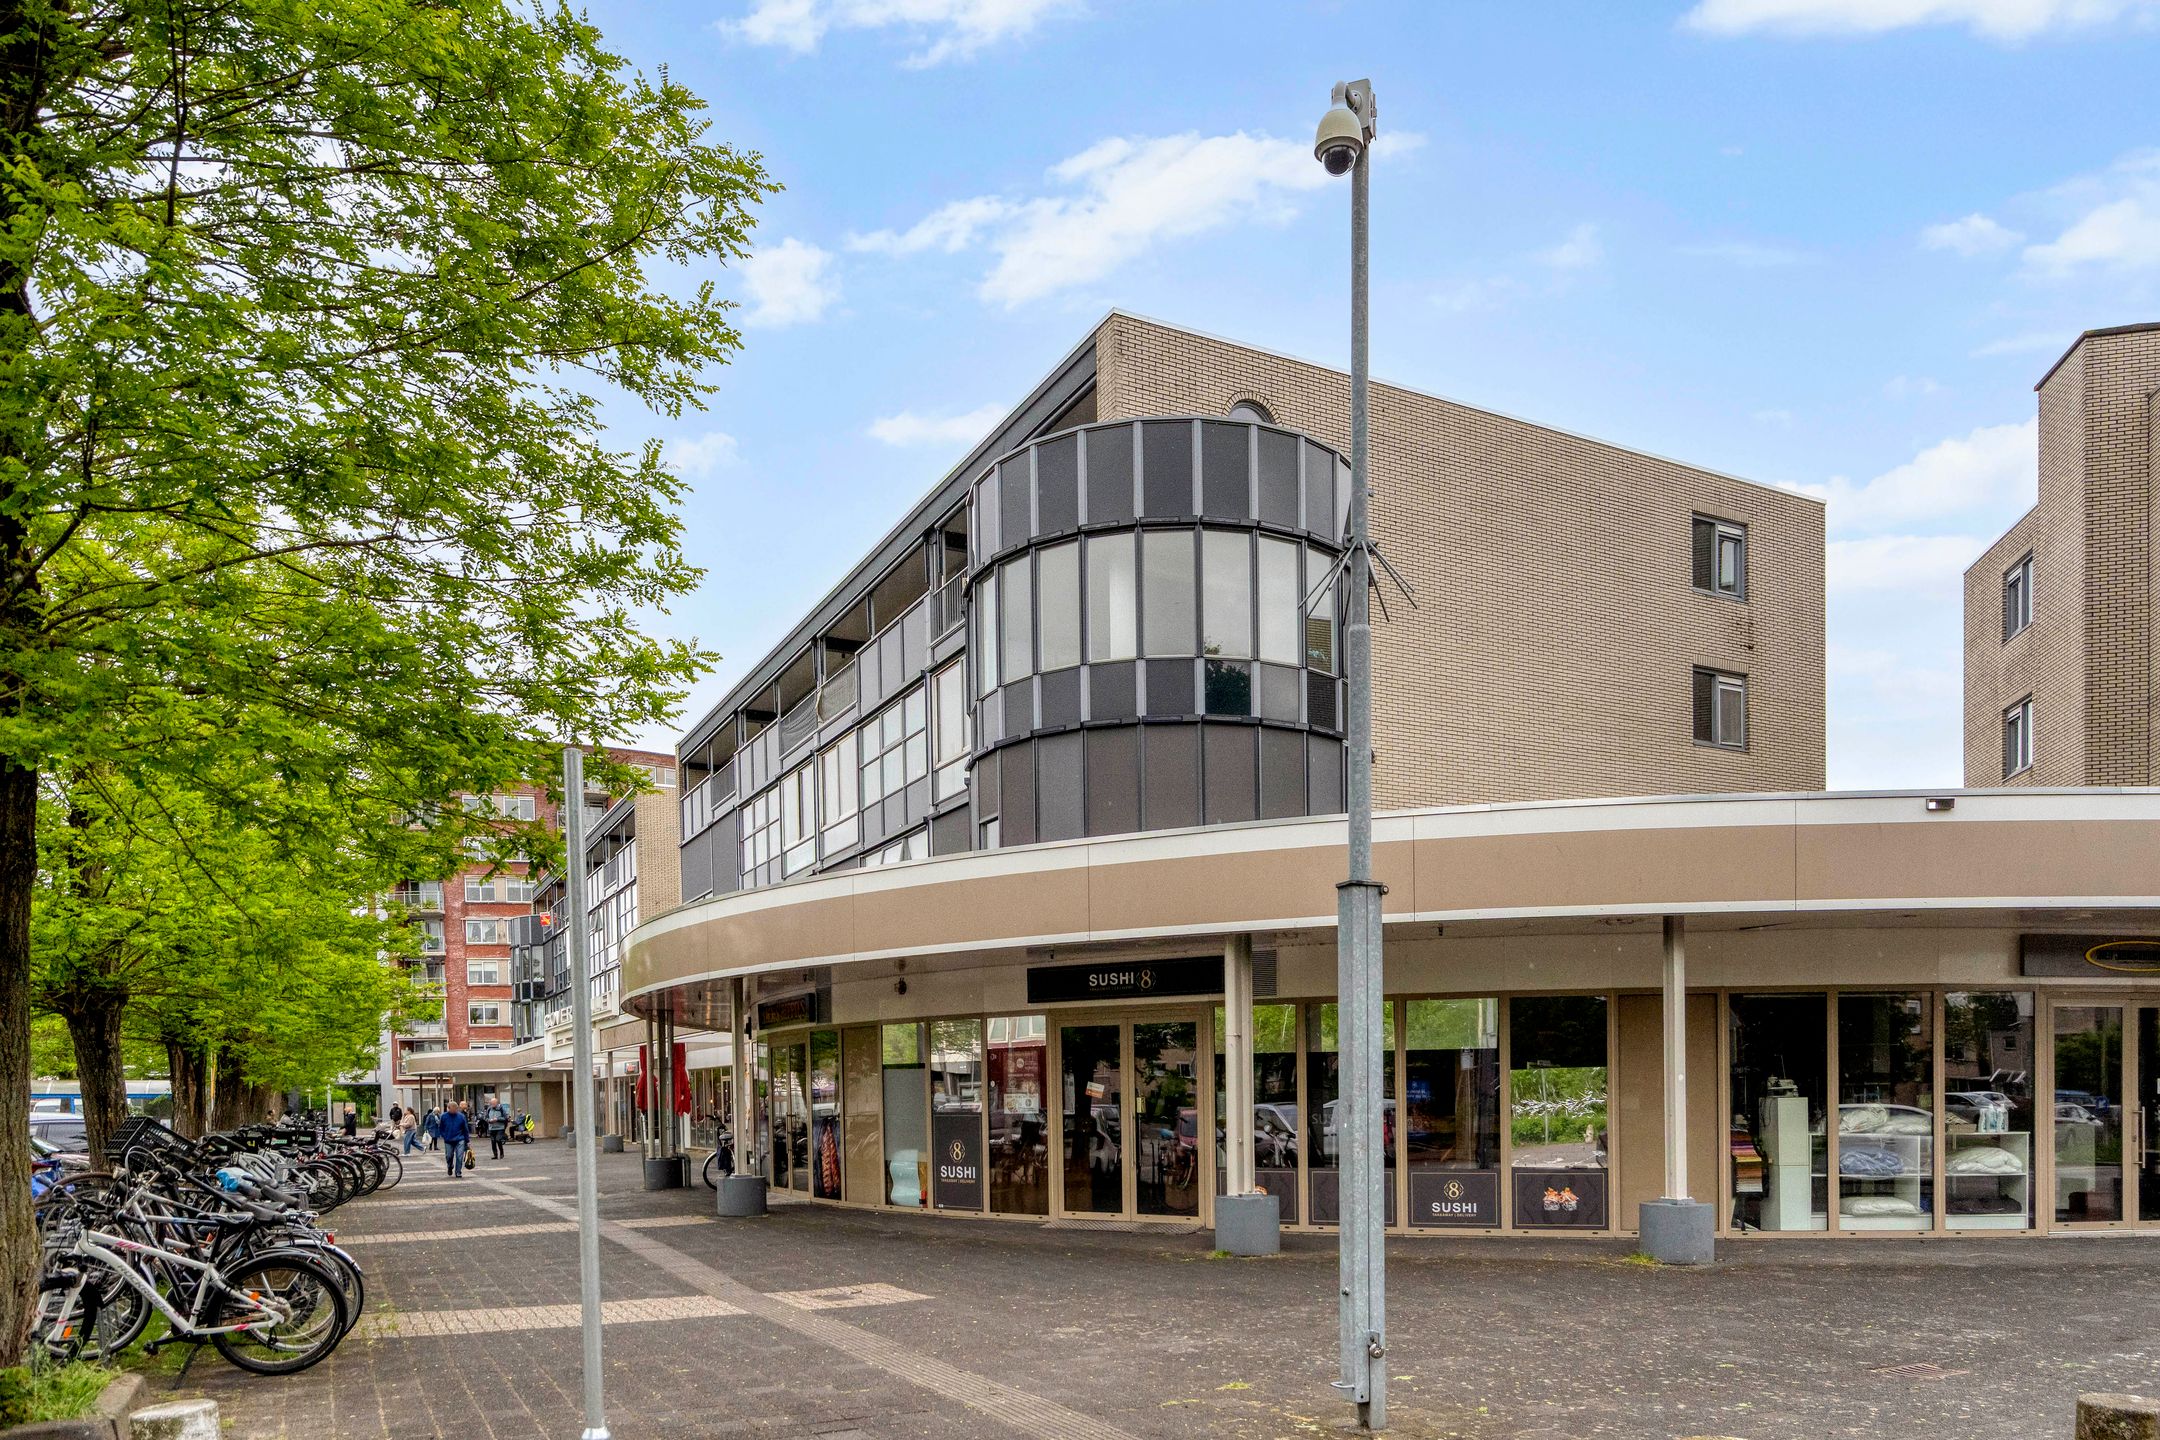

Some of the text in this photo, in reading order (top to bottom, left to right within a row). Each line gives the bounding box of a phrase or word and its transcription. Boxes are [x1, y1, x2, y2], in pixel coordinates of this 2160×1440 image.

[1089, 969, 1152, 989] SUSHI 8
[953, 1142, 962, 1161] 8
[940, 1165, 976, 1179] SUSHI
[1449, 1182, 1460, 1198] 8
[1431, 1202, 1478, 1213] SUSHI
